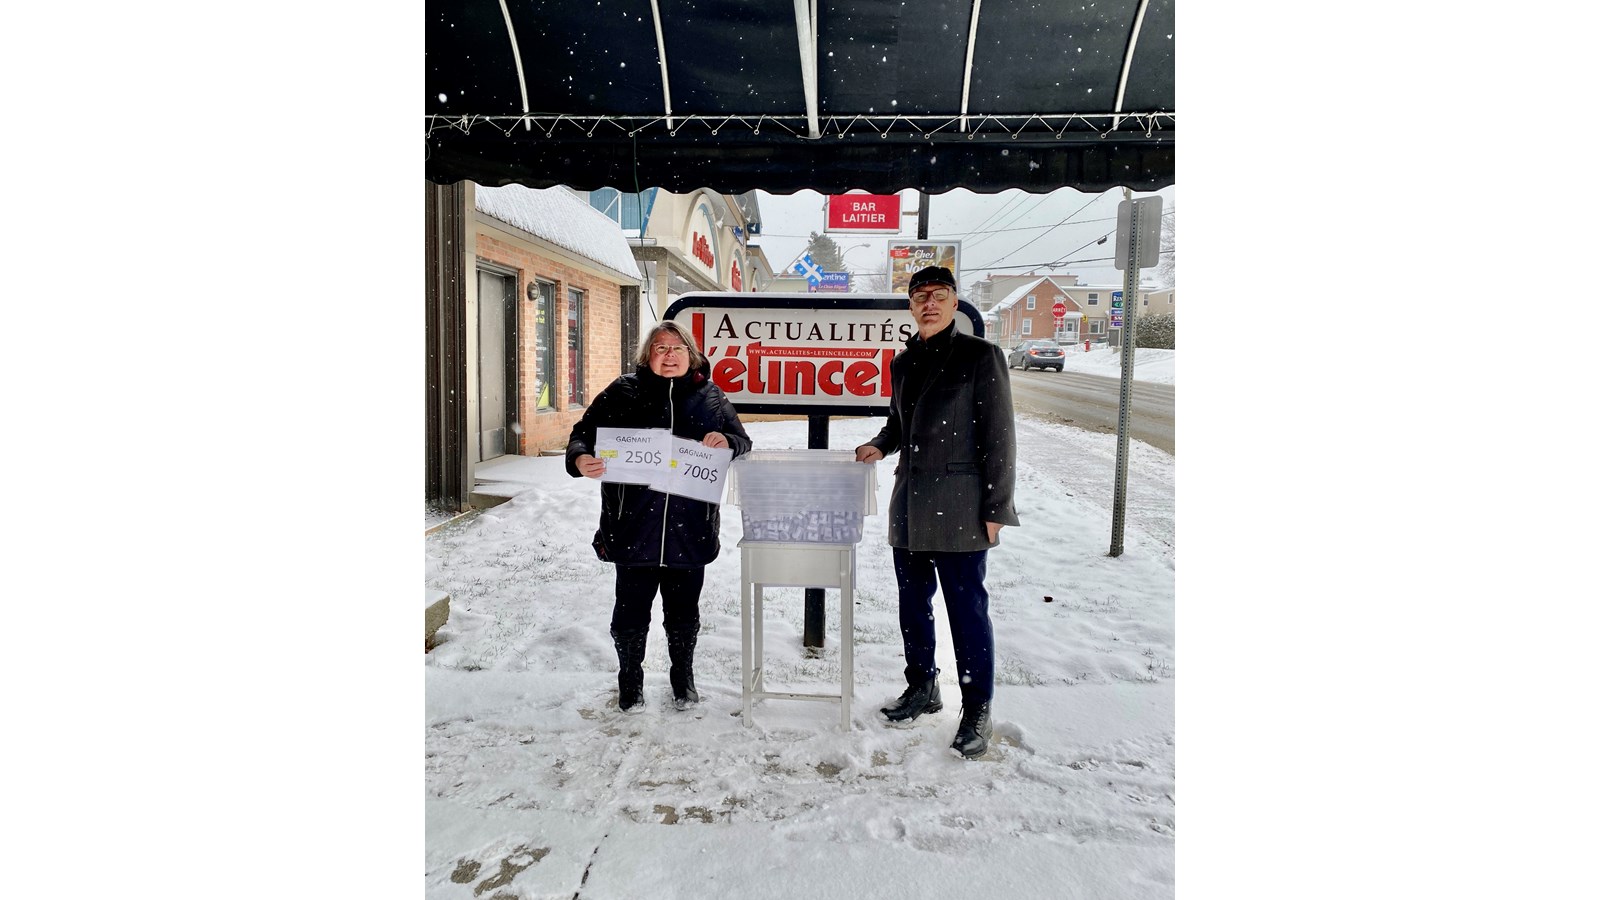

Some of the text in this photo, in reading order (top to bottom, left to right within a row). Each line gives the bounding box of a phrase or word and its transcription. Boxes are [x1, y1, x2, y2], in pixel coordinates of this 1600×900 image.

[853, 202, 876, 211] BAR
[842, 213, 885, 223] LAITIER
[914, 250, 934, 259] Chez
[823, 273, 846, 281] entine
[713, 313, 912, 342] ACTUALITÉS
[749, 348, 872, 357] WWW.ACTUALITES-LETINCELLE.COM
[625, 450, 662, 466] 250$
[678, 447, 712, 460] GAGNANT
[683, 463, 719, 483] 700$
